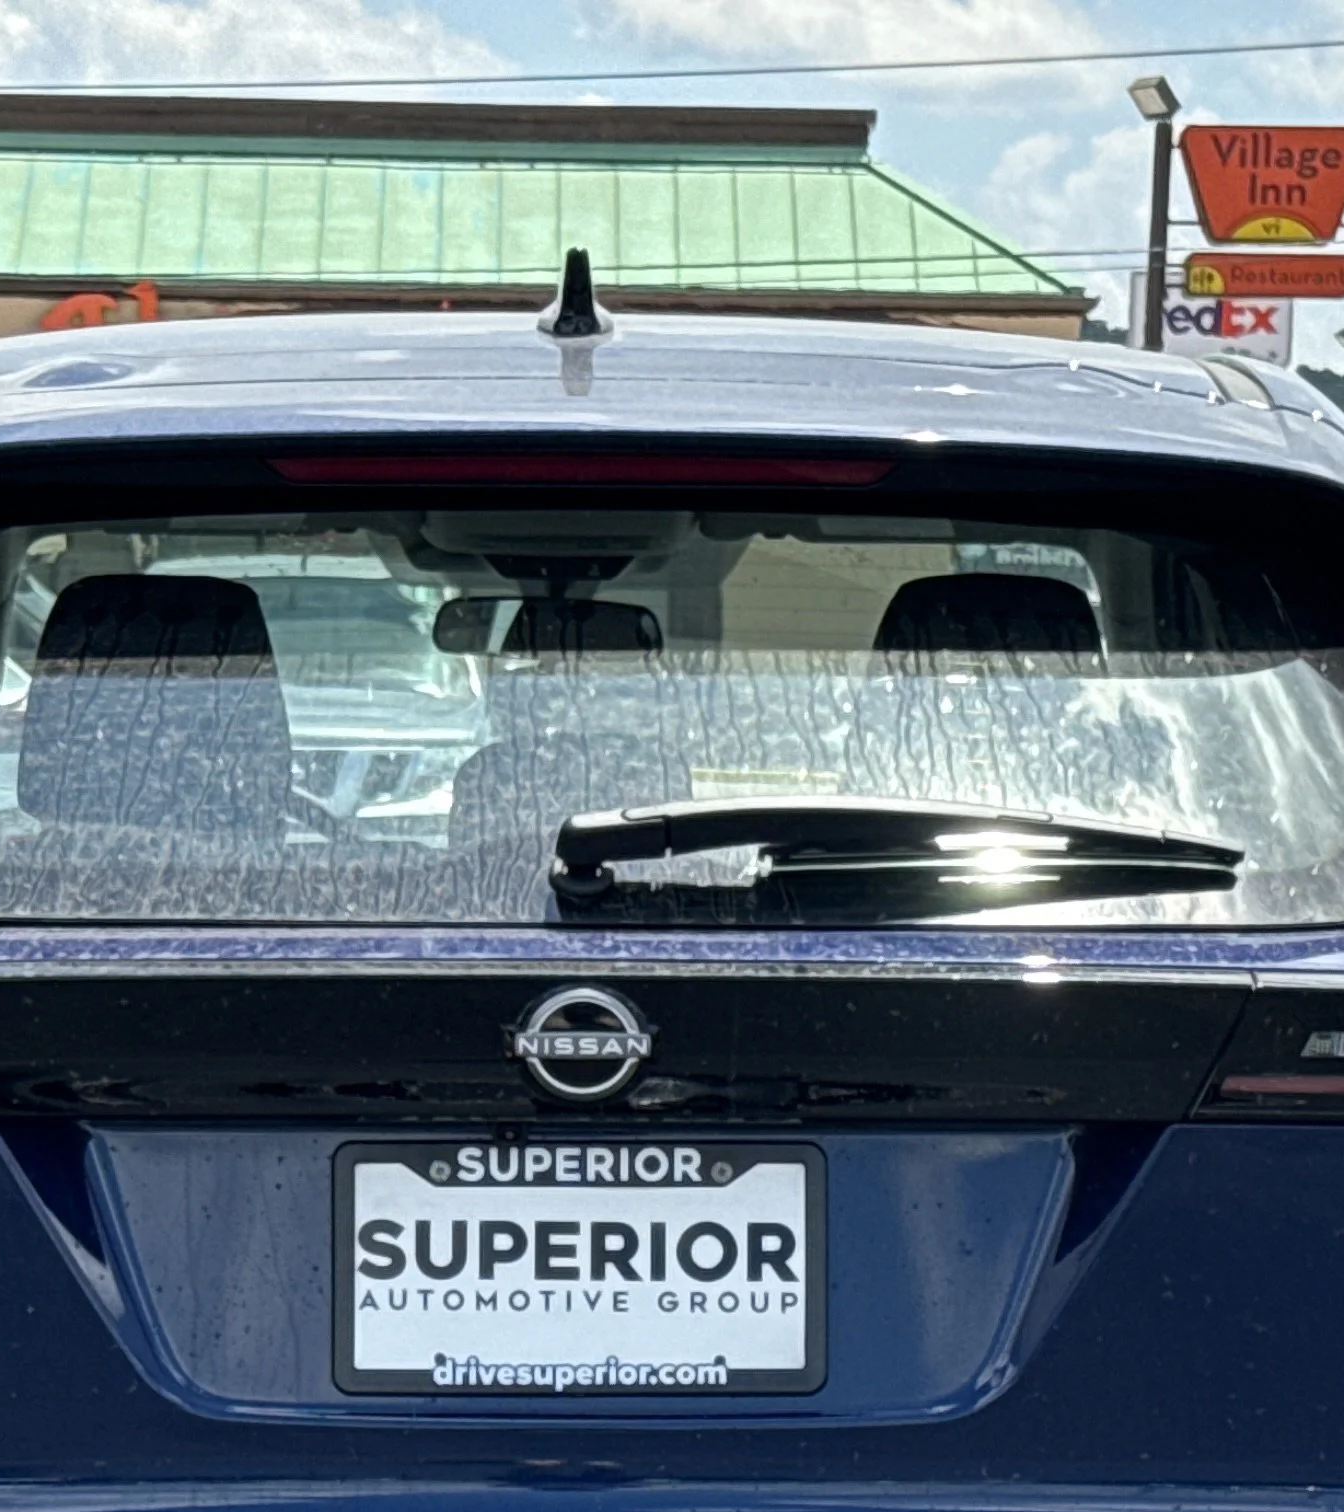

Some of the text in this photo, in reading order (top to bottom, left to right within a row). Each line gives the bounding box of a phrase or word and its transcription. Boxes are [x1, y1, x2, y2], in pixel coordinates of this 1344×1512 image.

[1210, 132, 1343, 179] Village
[1247, 174, 1307, 207] Inn
[1164, 299, 1279, 337] edEx
[518, 1036, 648, 1056] NISSAN
[456, 1146, 703, 1183] SUPERIOR
[356, 1218, 799, 1283] SUPERIOR
[358, 1288, 799, 1315] AUTOMOTIVE GROUP
[432, 1355, 728, 1392] drivesuperior.com
